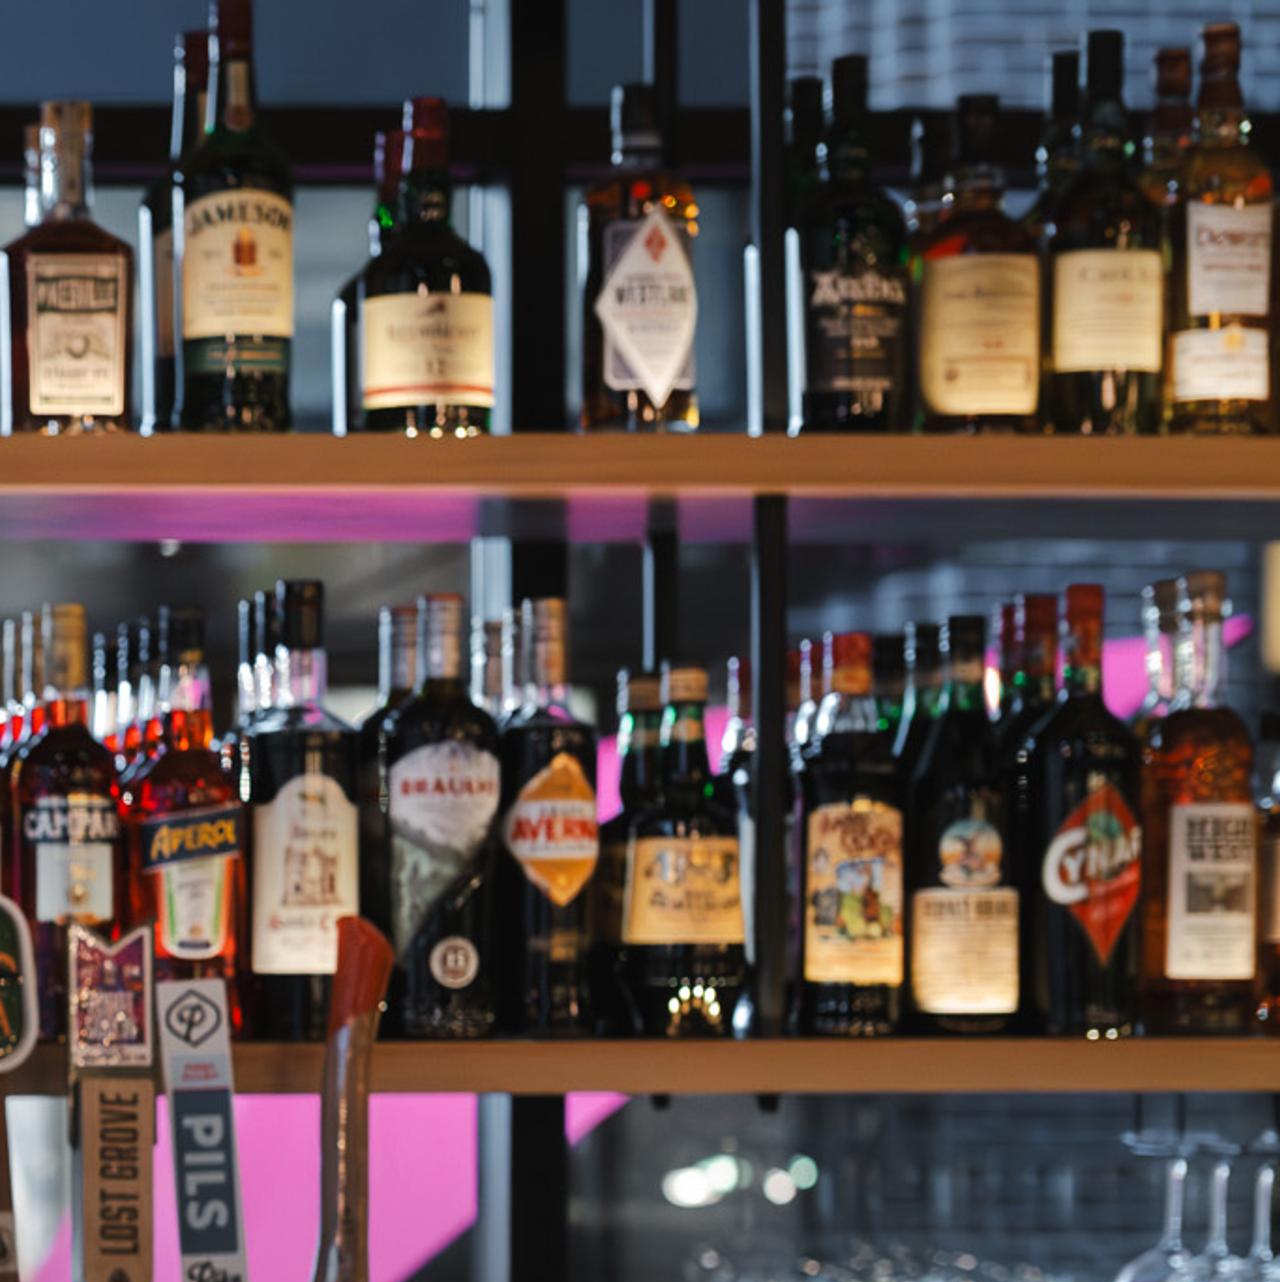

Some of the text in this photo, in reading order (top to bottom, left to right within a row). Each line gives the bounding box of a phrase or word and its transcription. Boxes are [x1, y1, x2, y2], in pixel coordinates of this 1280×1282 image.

[190, 199, 290, 236] JAMESON
[149, 819, 237, 861] APEROL
[511, 815, 597, 844] AVERN
[100, 1091, 139, 1181] GROVE
[182, 1114, 229, 1231] PILS
[100, 1188, 139, 1256] LOST
